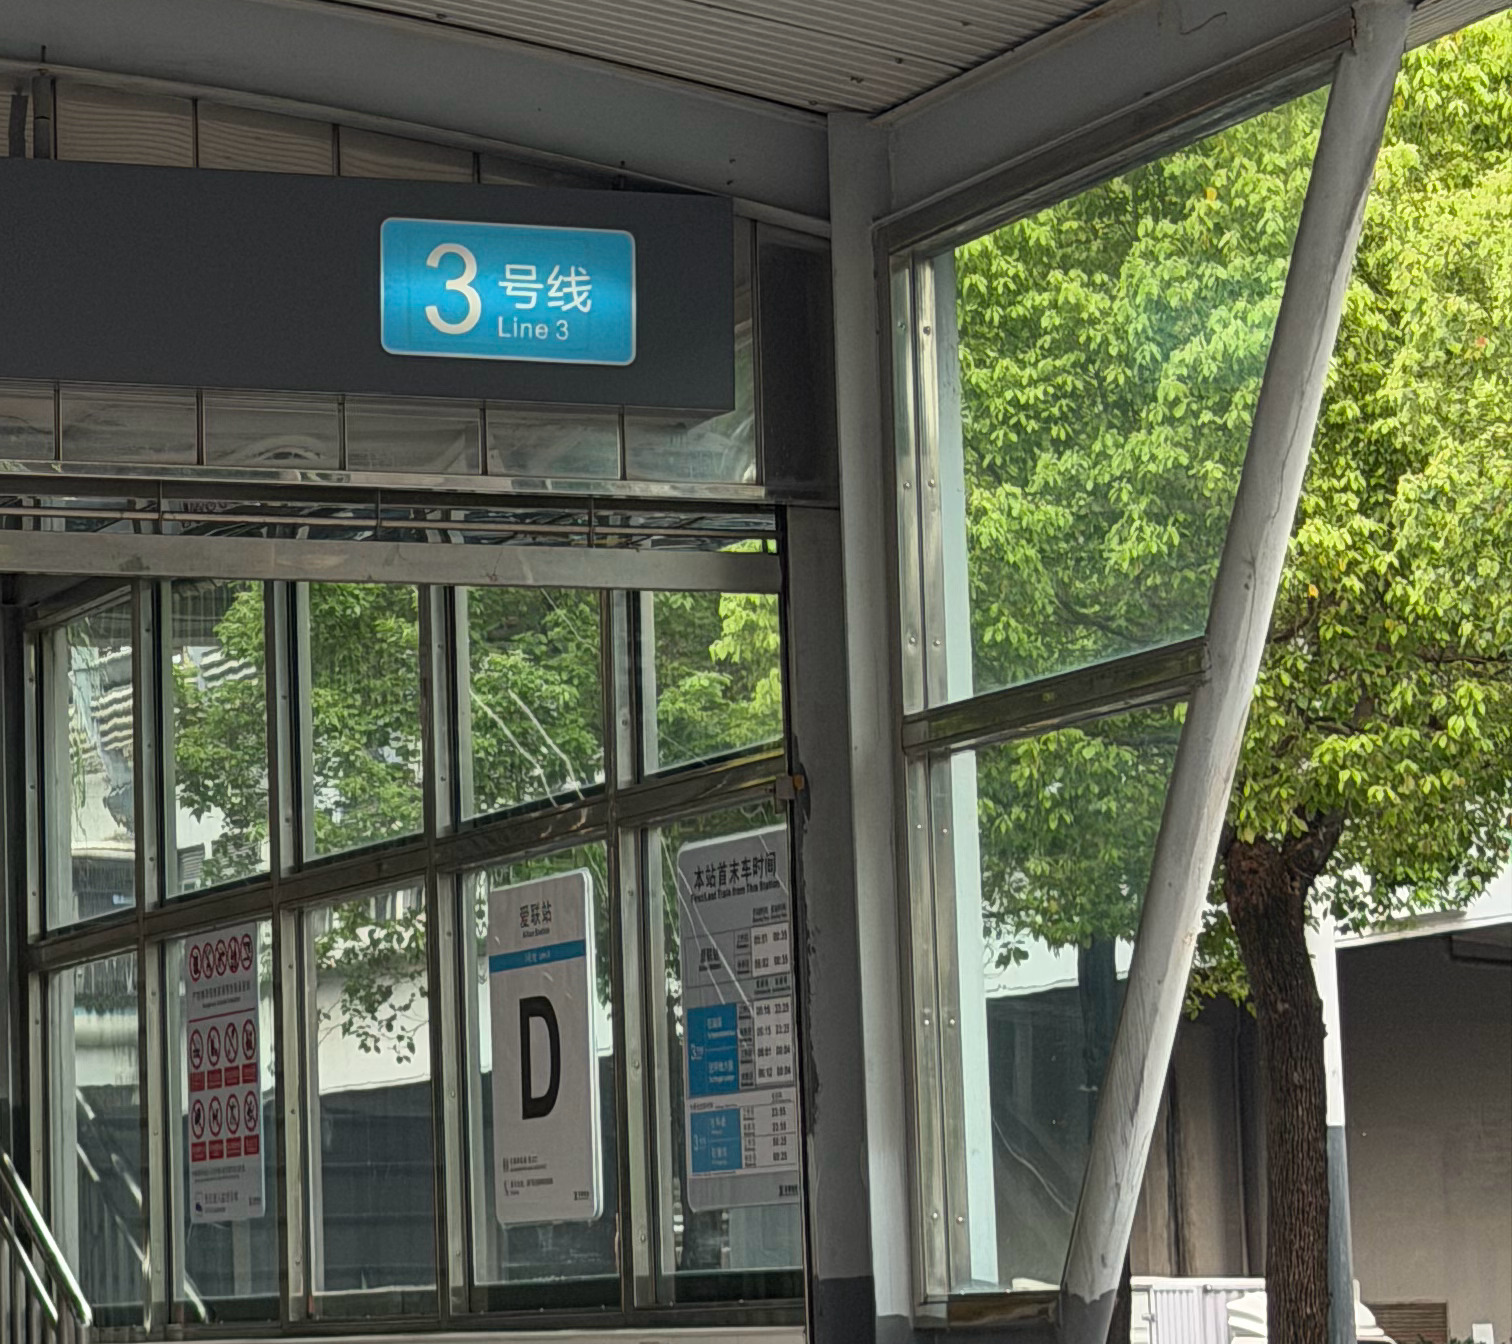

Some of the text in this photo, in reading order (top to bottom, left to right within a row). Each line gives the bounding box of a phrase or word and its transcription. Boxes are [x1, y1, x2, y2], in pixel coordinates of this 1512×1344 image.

[497, 316, 569, 340] Line 3
[694, 851, 776, 891] 本站首末车时间
[519, 995, 561, 1121] D
